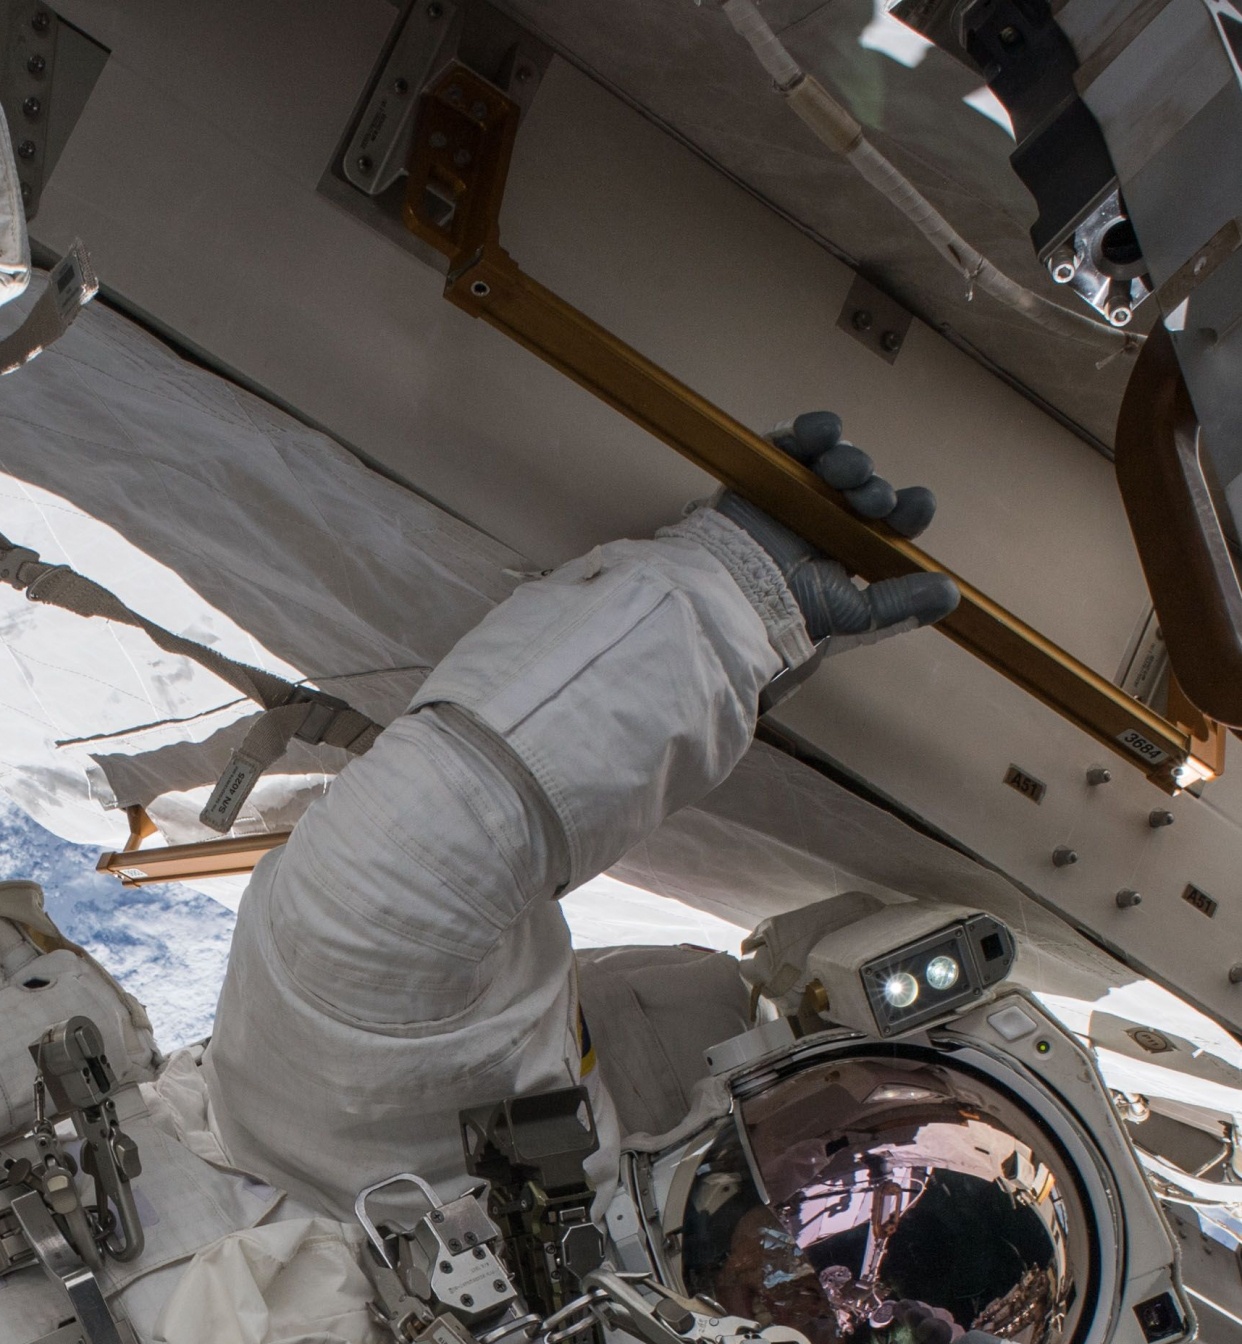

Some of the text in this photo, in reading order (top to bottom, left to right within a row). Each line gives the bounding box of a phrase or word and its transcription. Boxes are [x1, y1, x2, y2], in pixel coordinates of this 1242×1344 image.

[1124, 733, 1162, 759] 3684
[217, 796, 232, 814] S/N
[228, 771, 246, 796] 4025
[1011, 772, 1038, 798] A51
[1187, 888, 1214, 915] A51
